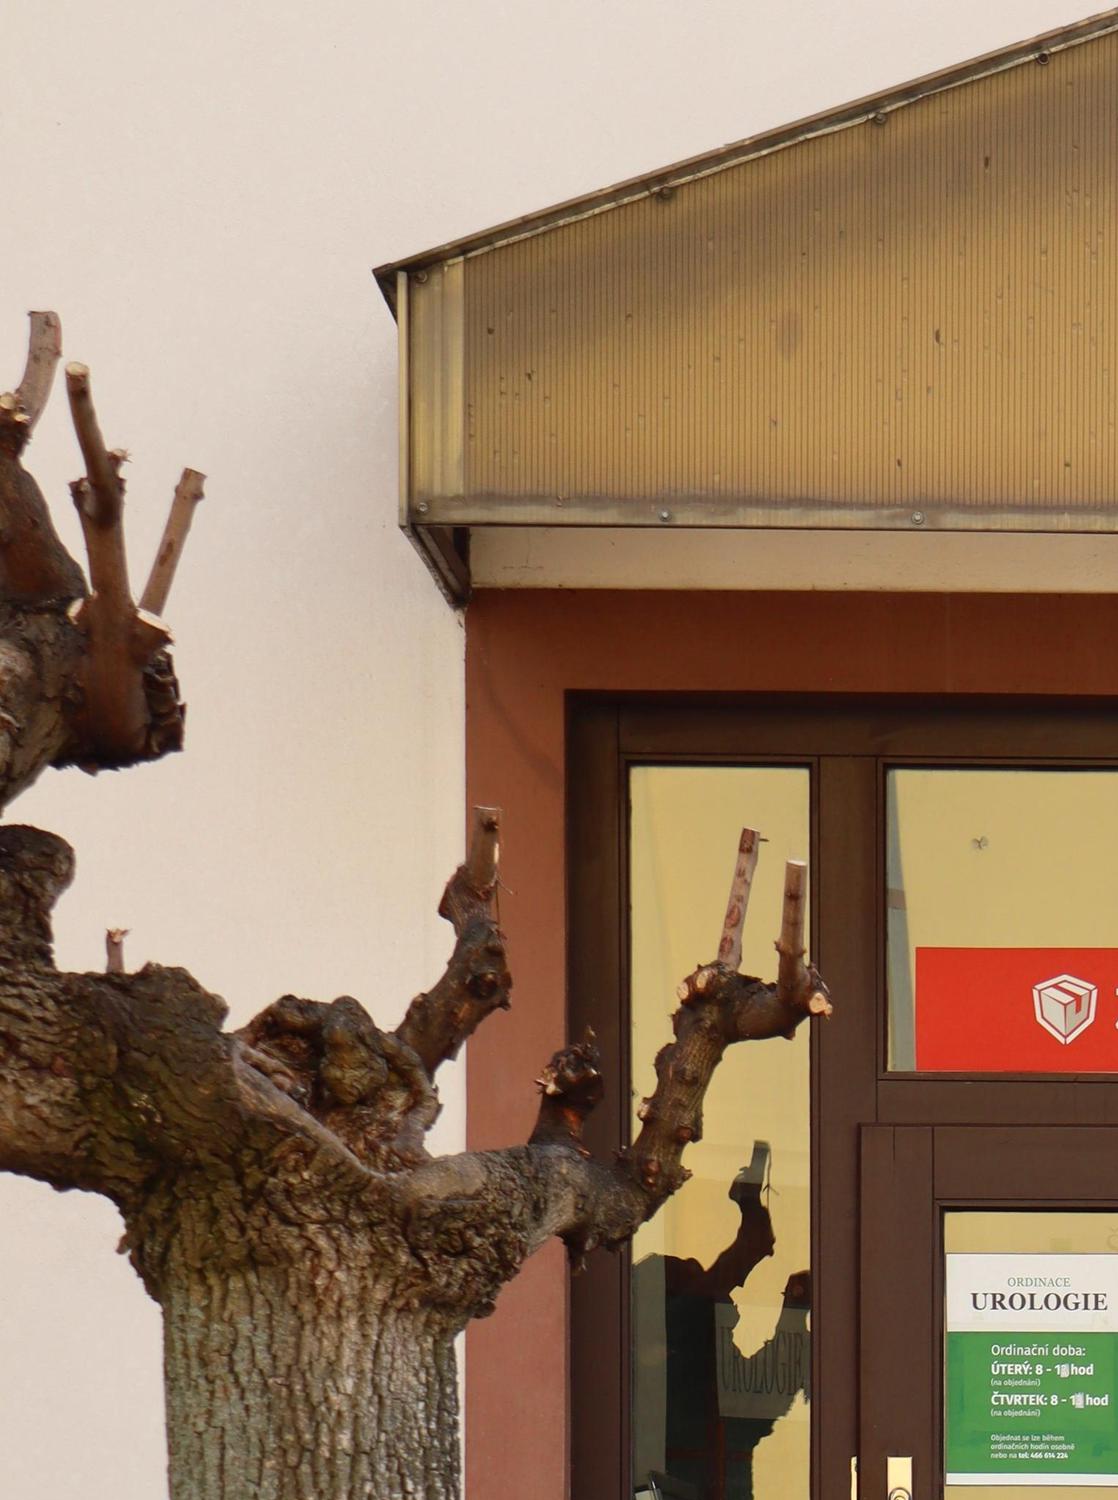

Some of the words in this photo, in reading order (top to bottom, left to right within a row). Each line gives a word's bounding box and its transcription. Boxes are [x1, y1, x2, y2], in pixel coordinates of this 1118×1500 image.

[1007, 1277, 1071, 1288] ORDINACE
[971, 1292, 1108, 1311] UROLOGIE
[991, 1344, 1049, 1356] Ordinační
[1052, 1344, 1086, 1356] doba:
[991, 1361, 1033, 1375] ÚTERÝ:
[1035, 1364, 1043, 1375] 8
[1071, 1363, 1094, 1375] hod
[990, 1378, 1002, 1387] (na
[991, 1391, 1048, 1406] ČTVRTEK:
[1050, 1394, 1059, 1406] 8
[1086, 1394, 1109, 1406] hod
[990, 1408, 1002, 1417] (na
